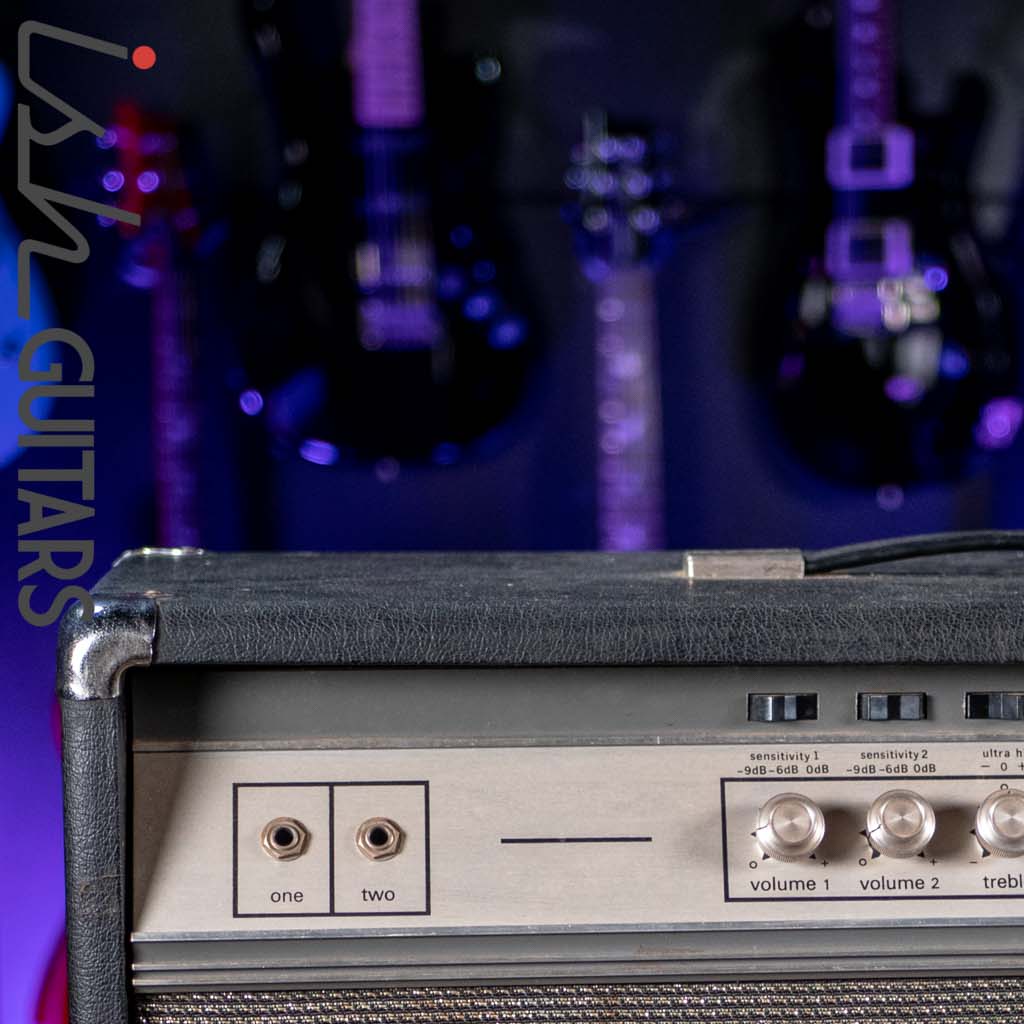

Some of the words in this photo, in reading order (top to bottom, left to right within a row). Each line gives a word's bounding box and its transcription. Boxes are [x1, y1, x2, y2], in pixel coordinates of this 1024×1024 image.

[750, 751, 811, 763] sensitivity
[813, 751, 820, 761] 1
[860, 750, 919, 762] sensitivity
[921, 749, 929, 760] 2
[982, 749, 1011, 758] ultra
[737, 765, 768, 775] -9dB
[769, 764, 799, 775] -6dB
[806, 764, 830, 774] 0dB
[846, 764, 877, 775] -9dB
[879, 763, 909, 774] -6dB
[913, 763, 937, 773] 0dB
[750, 876, 817, 891] volume
[823, 878, 830, 890] 1
[860, 876, 925, 890] volume
[931, 877, 940, 889] 2
[270, 890, 304, 903] one
[361, 888, 396, 902] two
